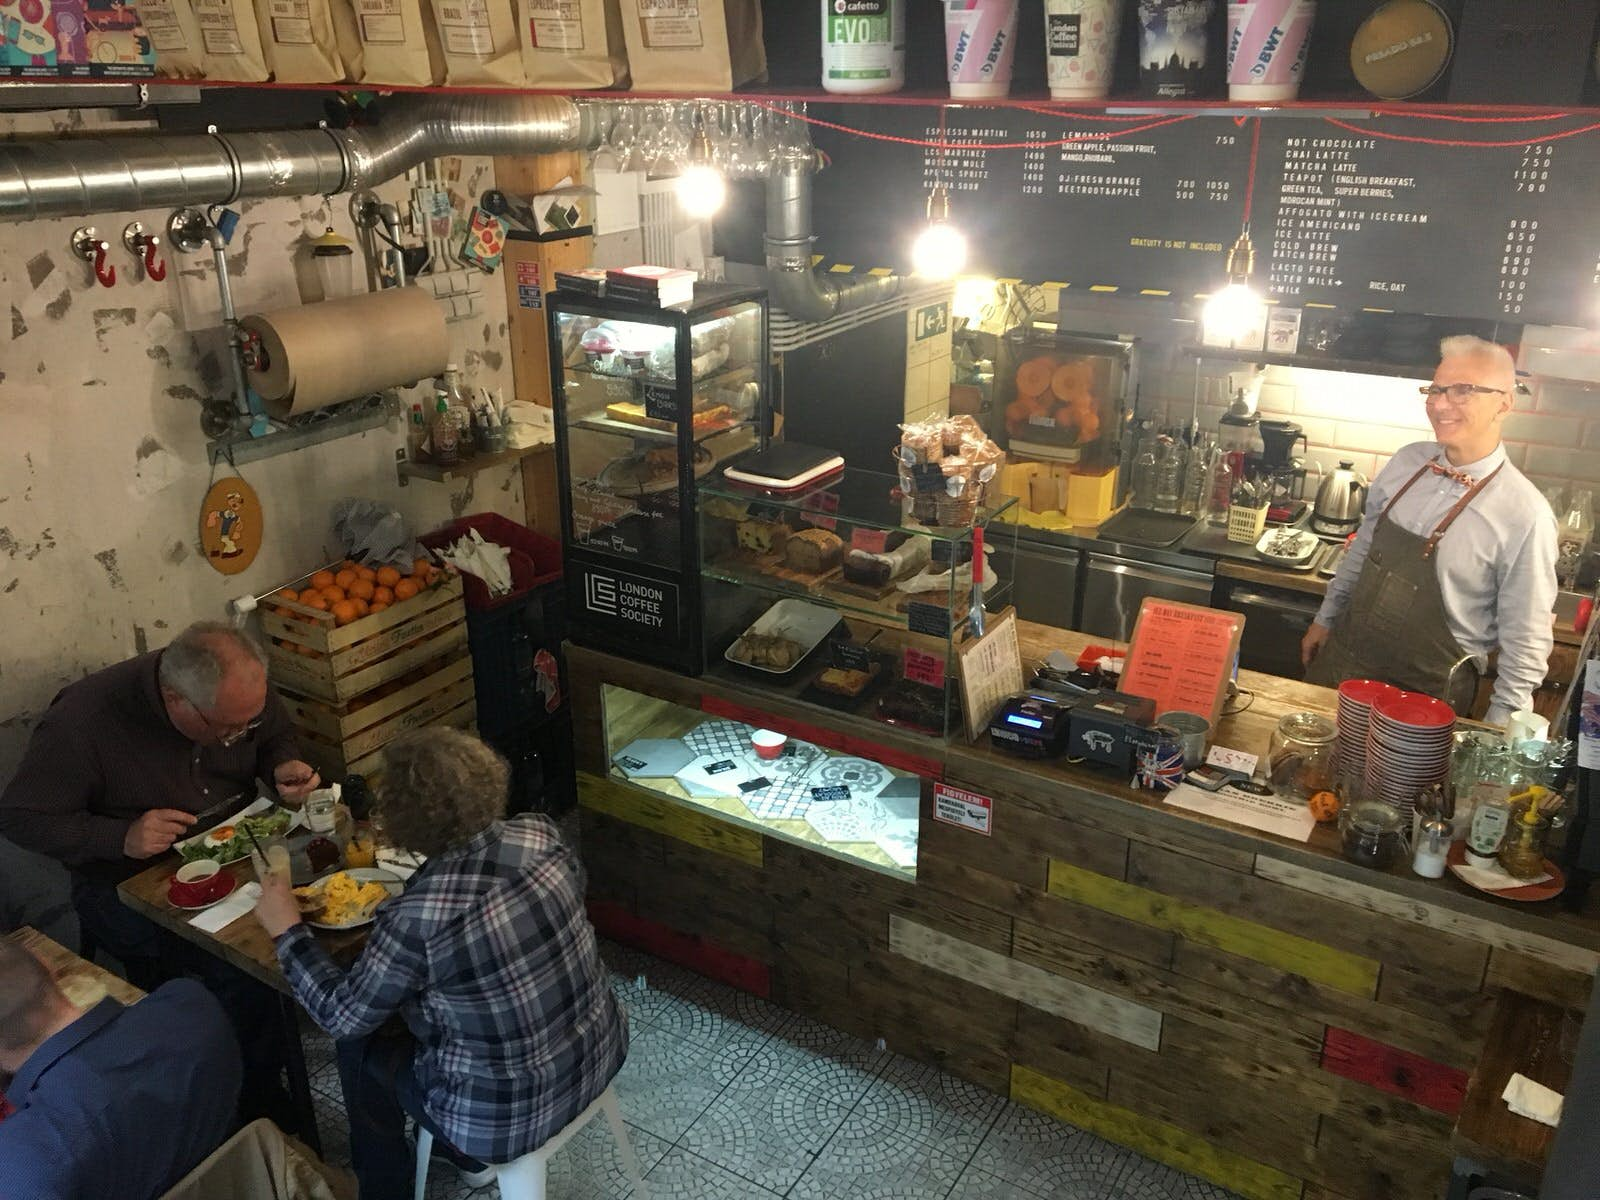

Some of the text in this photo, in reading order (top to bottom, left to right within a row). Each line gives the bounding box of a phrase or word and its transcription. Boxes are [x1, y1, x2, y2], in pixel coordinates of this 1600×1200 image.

[848, 1, 879, 10] cafetto
[834, 18, 870, 43] EVO
[954, 30, 970, 63] BWT
[987, 30, 1006, 63] BWT
[1258, 26, 1283, 63] BWT
[972, 129, 1008, 137] MARTINI
[1216, 136, 1235, 145] 750
[1287, 138, 1376, 149] HOT CHOCOLATE
[944, 150, 986, 158] MARTINEZ
[1084, 143, 1106, 152] APPLE,
[1107, 144, 1134, 152] PASSION
[1134, 145, 1157, 155] FRUIT,
[1524, 146, 1553, 155] 750
[1286, 150, 1350, 160] CHAI LATTE
[963, 160, 985, 168] MULE
[1284, 162, 1358, 172] MATCHA LATTE
[1521, 158, 1550, 167] 750
[1106, 176, 1141, 186] ORANGE
[1283, 173, 1323, 182] TEAPOT
[1369, 176, 1416, 188] BREAKFAST,
[1514, 171, 1548, 180] 1100
[957, 182, 979, 190] SOUR
[1281, 184, 1305, 193] GREEN
[1334, 187, 1359, 196] SUPER
[1360, 188, 1394, 199] BERRIES,
[1210, 192, 1229, 201] 750
[1278, 208, 1428, 224] AFFOGATO WITH ICECREAM
[1277, 219, 1361, 231] ICE AMERICANO
[1275, 230, 1331, 241] ICE LATTE
[1130, 238, 1161, 247] GRATUITY
[1189, 242, 1222, 251] INCLUDED
[1273, 241, 1338, 252] COLD BREW
[1273, 251, 1338, 262] BATCH BREW
[1271, 263, 1335, 275] LACTO FREE
[1270, 275, 1407, 292] ALTER MILK RICE, OAT
[1501, 280, 1526, 290] 100
[1498, 292, 1523, 302] 150
[1504, 305, 1521, 313] 50
[619, 580, 663, 601] LONDON
[620, 594, 660, 614] COFFEE
[620, 608, 663, 628] SOCIETY
